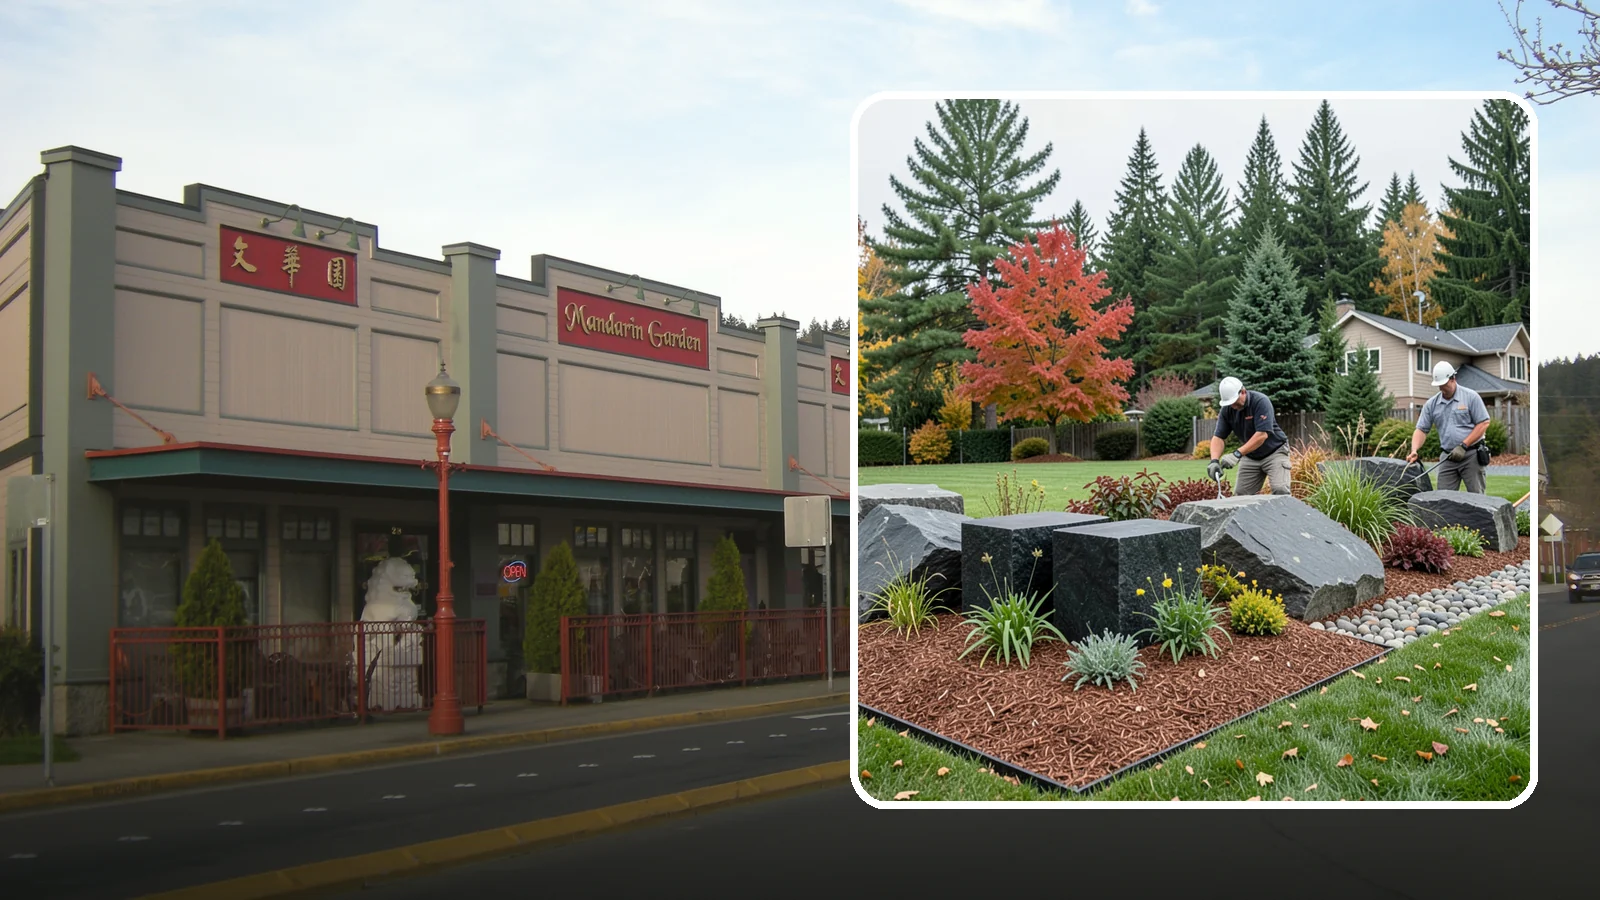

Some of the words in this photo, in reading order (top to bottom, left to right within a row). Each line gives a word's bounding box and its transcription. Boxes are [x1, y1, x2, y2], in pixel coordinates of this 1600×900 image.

[231, 235, 346, 291] 文華園
[564, 302, 644, 341] Mandarin
[648, 320, 701, 352] Garden
[503, 566, 526, 578] OPEN
